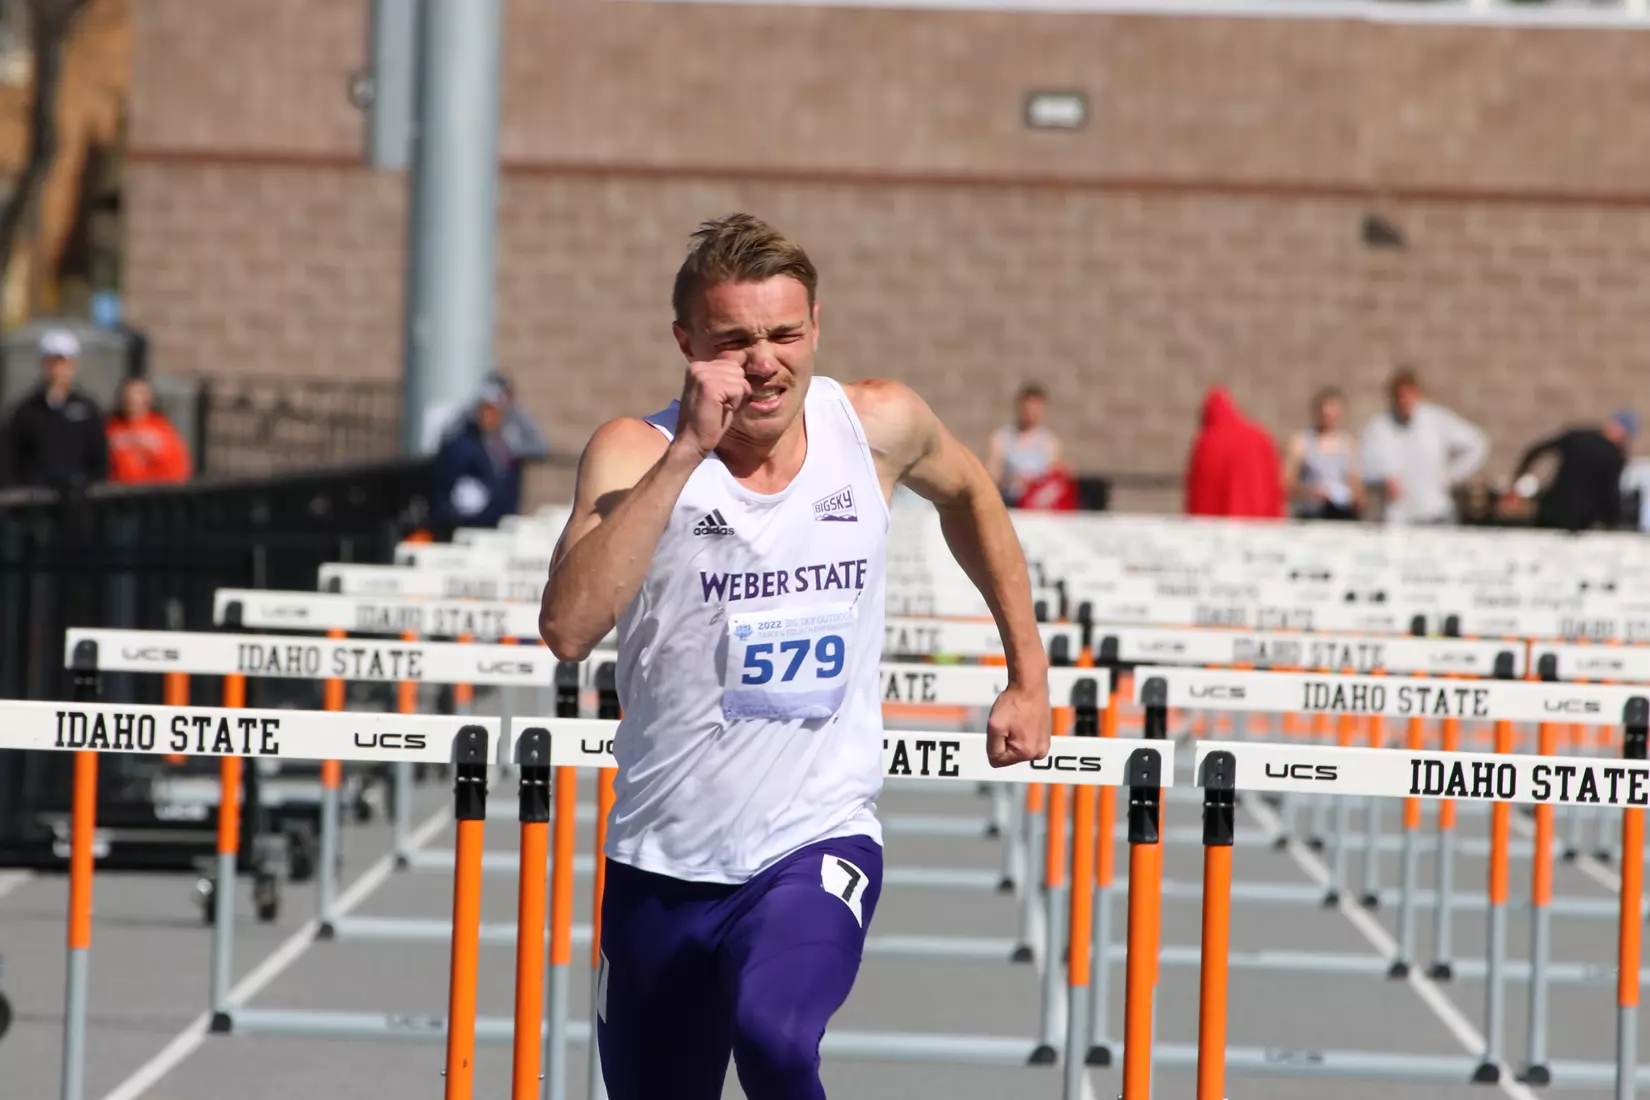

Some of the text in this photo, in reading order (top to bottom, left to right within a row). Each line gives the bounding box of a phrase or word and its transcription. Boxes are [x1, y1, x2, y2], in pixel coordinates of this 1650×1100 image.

[693, 526, 735, 536] adidas
[700, 559, 868, 603] WEBER STATE
[758, 620, 783, 630] 2022
[122, 643, 534, 679] UCS IDAHO STATE UCS
[741, 635, 845, 685] 579
[1189, 682, 1601, 717] UCS IDAHO STATE UCS
[55, 711, 427, 755] IDAHO STATE UCS
[883, 739, 1102, 777] ATE UCS
[1265, 759, 1649, 805] UCS IDAHO STATE
[836, 858, 862, 903] 7
